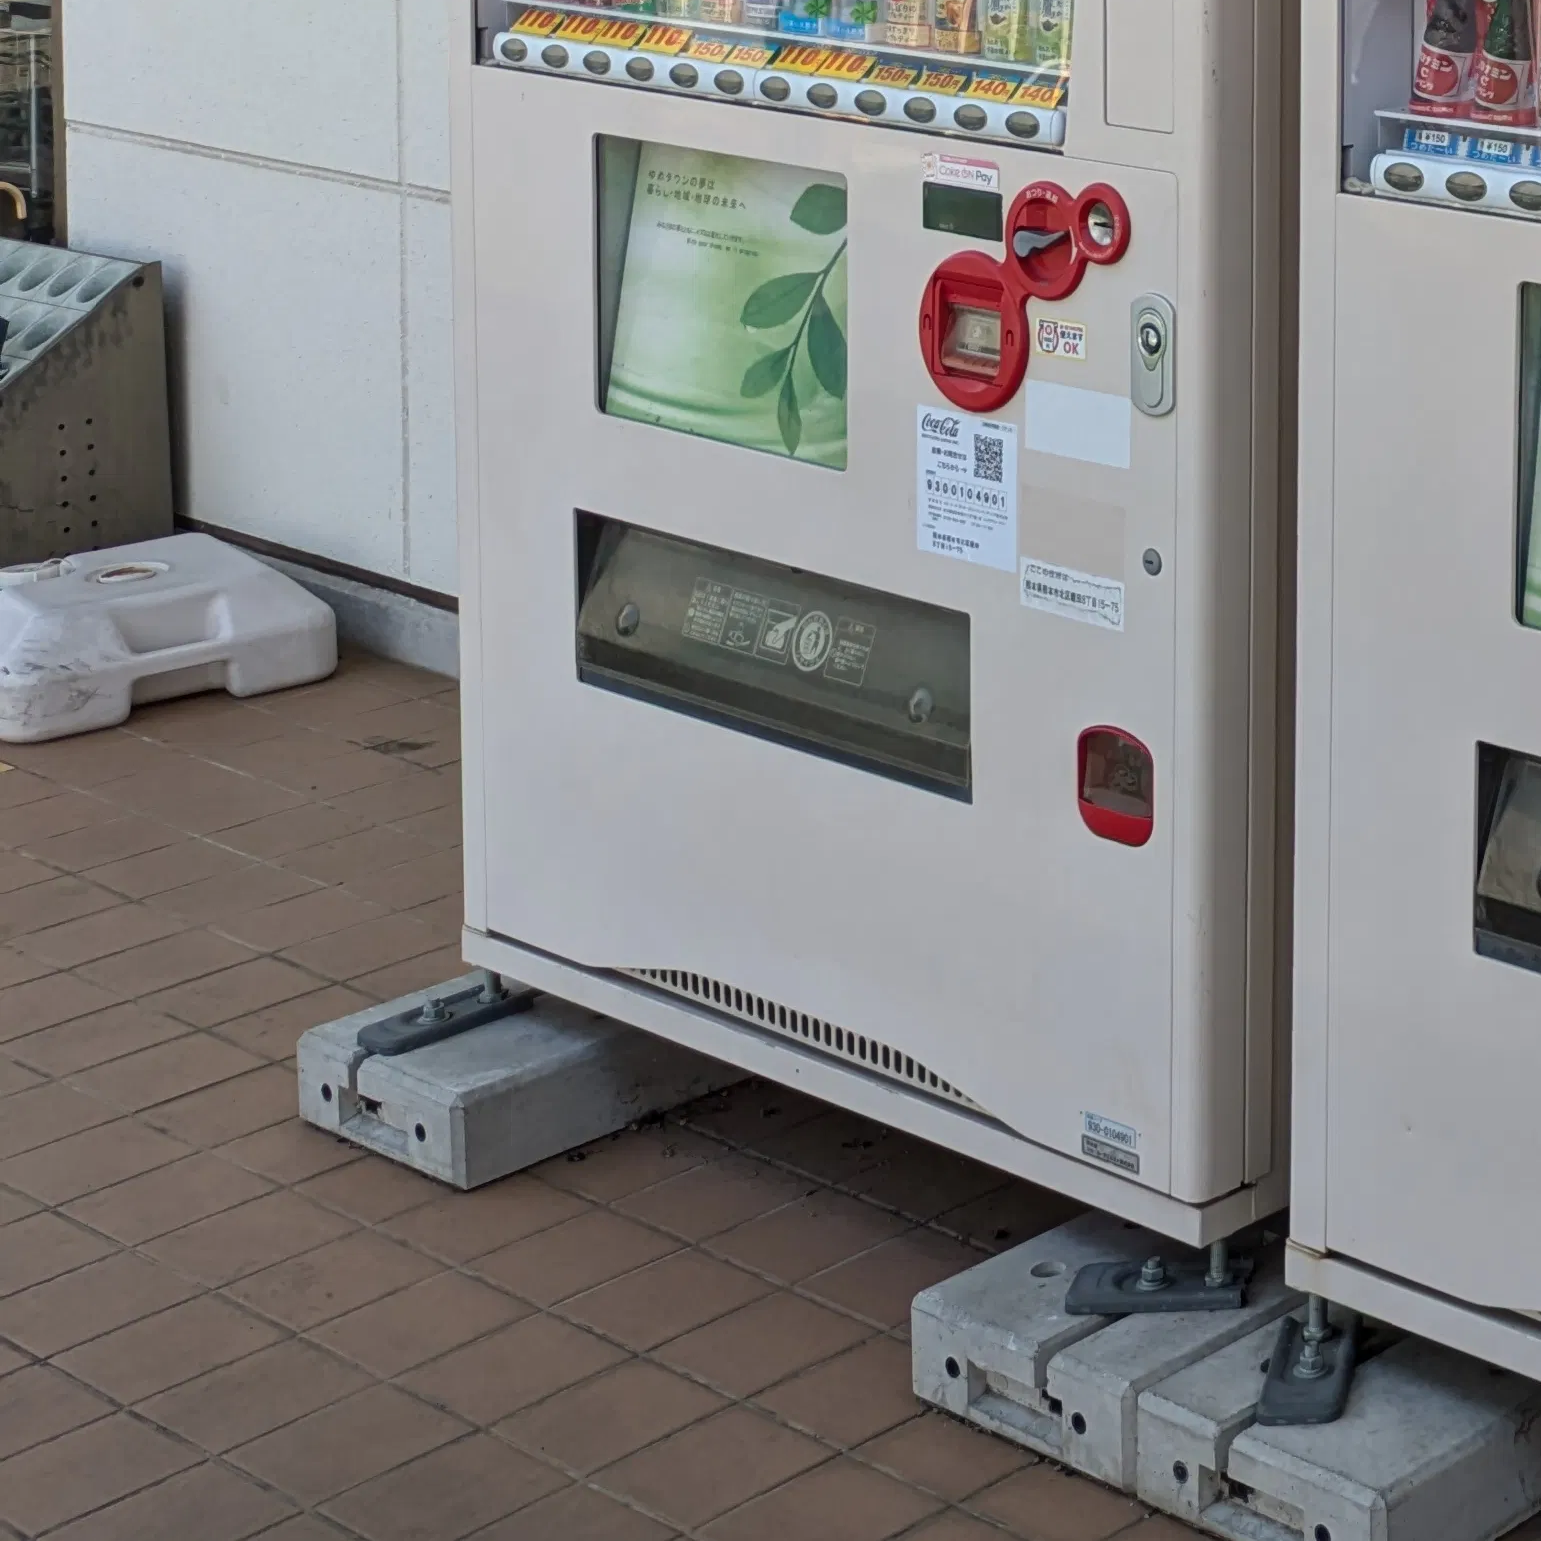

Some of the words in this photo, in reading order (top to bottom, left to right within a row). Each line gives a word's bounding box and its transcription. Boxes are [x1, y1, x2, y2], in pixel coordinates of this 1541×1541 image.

[939, 165, 961, 179] Coke
[976, 170, 993, 185] Pay
[1063, 342, 1079, 356] OK
[921, 412, 961, 438] Coca-Cola
